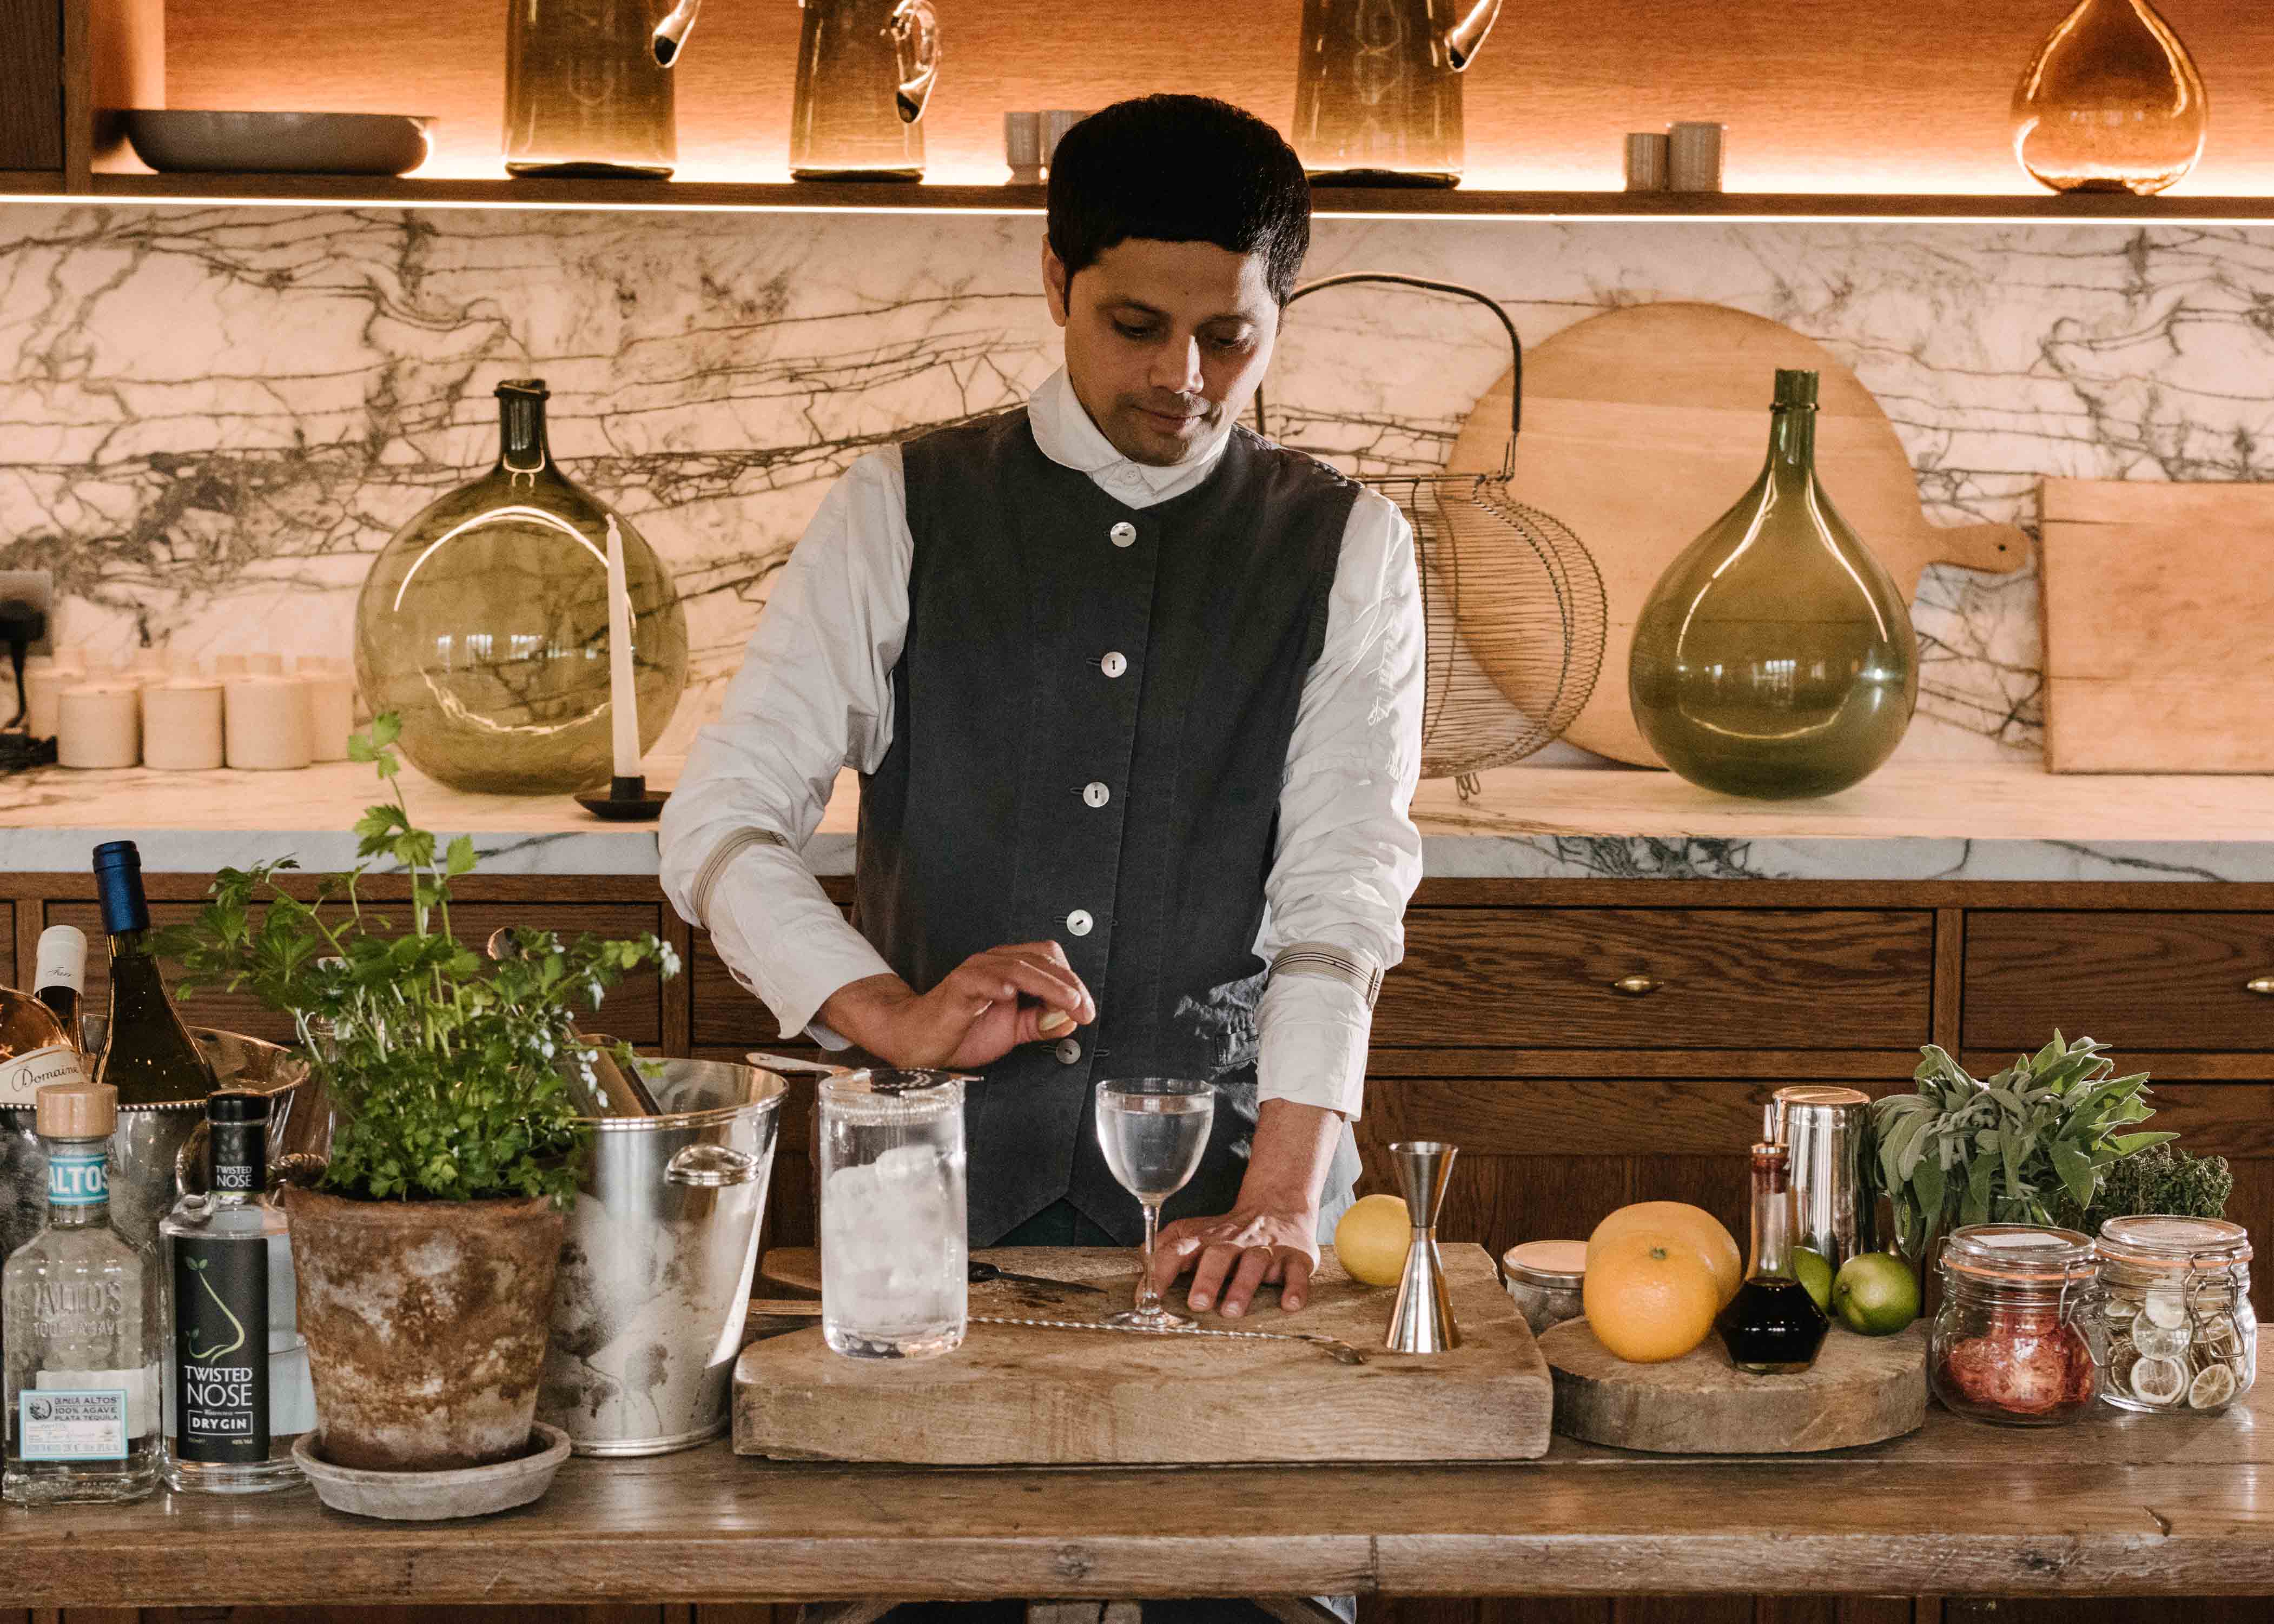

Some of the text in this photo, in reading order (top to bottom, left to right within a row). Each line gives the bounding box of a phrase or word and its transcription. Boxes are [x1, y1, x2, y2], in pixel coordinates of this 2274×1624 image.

[12, 1064, 78, 1092] Domaine
[216, 1165, 252, 1174] TWISTED
[217, 1175, 252, 1188] NOSE
[184, 1365, 253, 1382] TWISTED
[187, 1382, 253, 1407] NOSE
